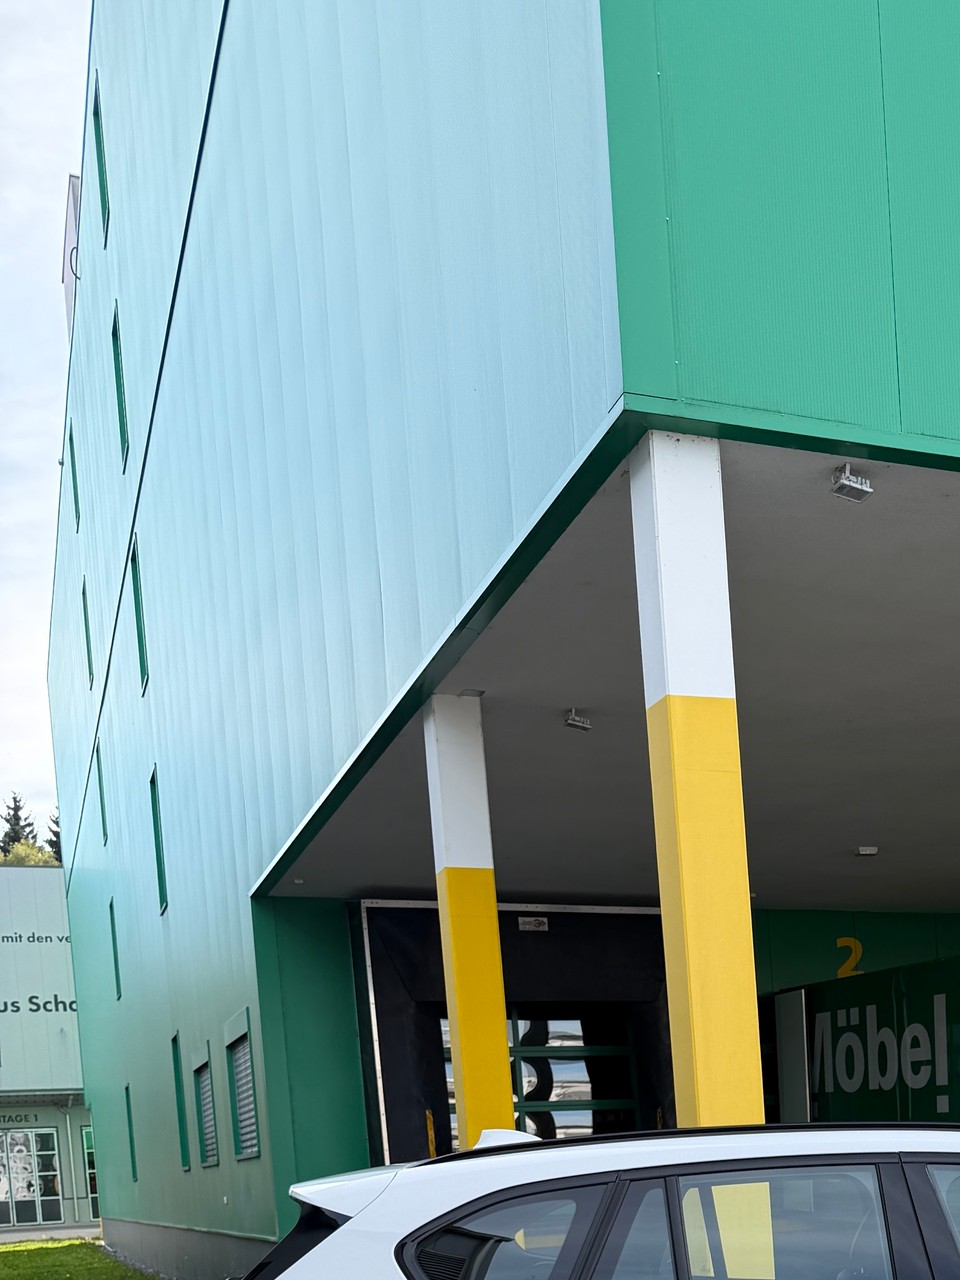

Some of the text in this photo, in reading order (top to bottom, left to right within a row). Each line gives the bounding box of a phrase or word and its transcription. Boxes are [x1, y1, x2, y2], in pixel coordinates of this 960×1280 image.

[1, 931, 23, 943] mit
[27, 931, 53, 943] den
[835, 936, 865, 978] 2
[0, 1114, 30, 1123] TAGE
